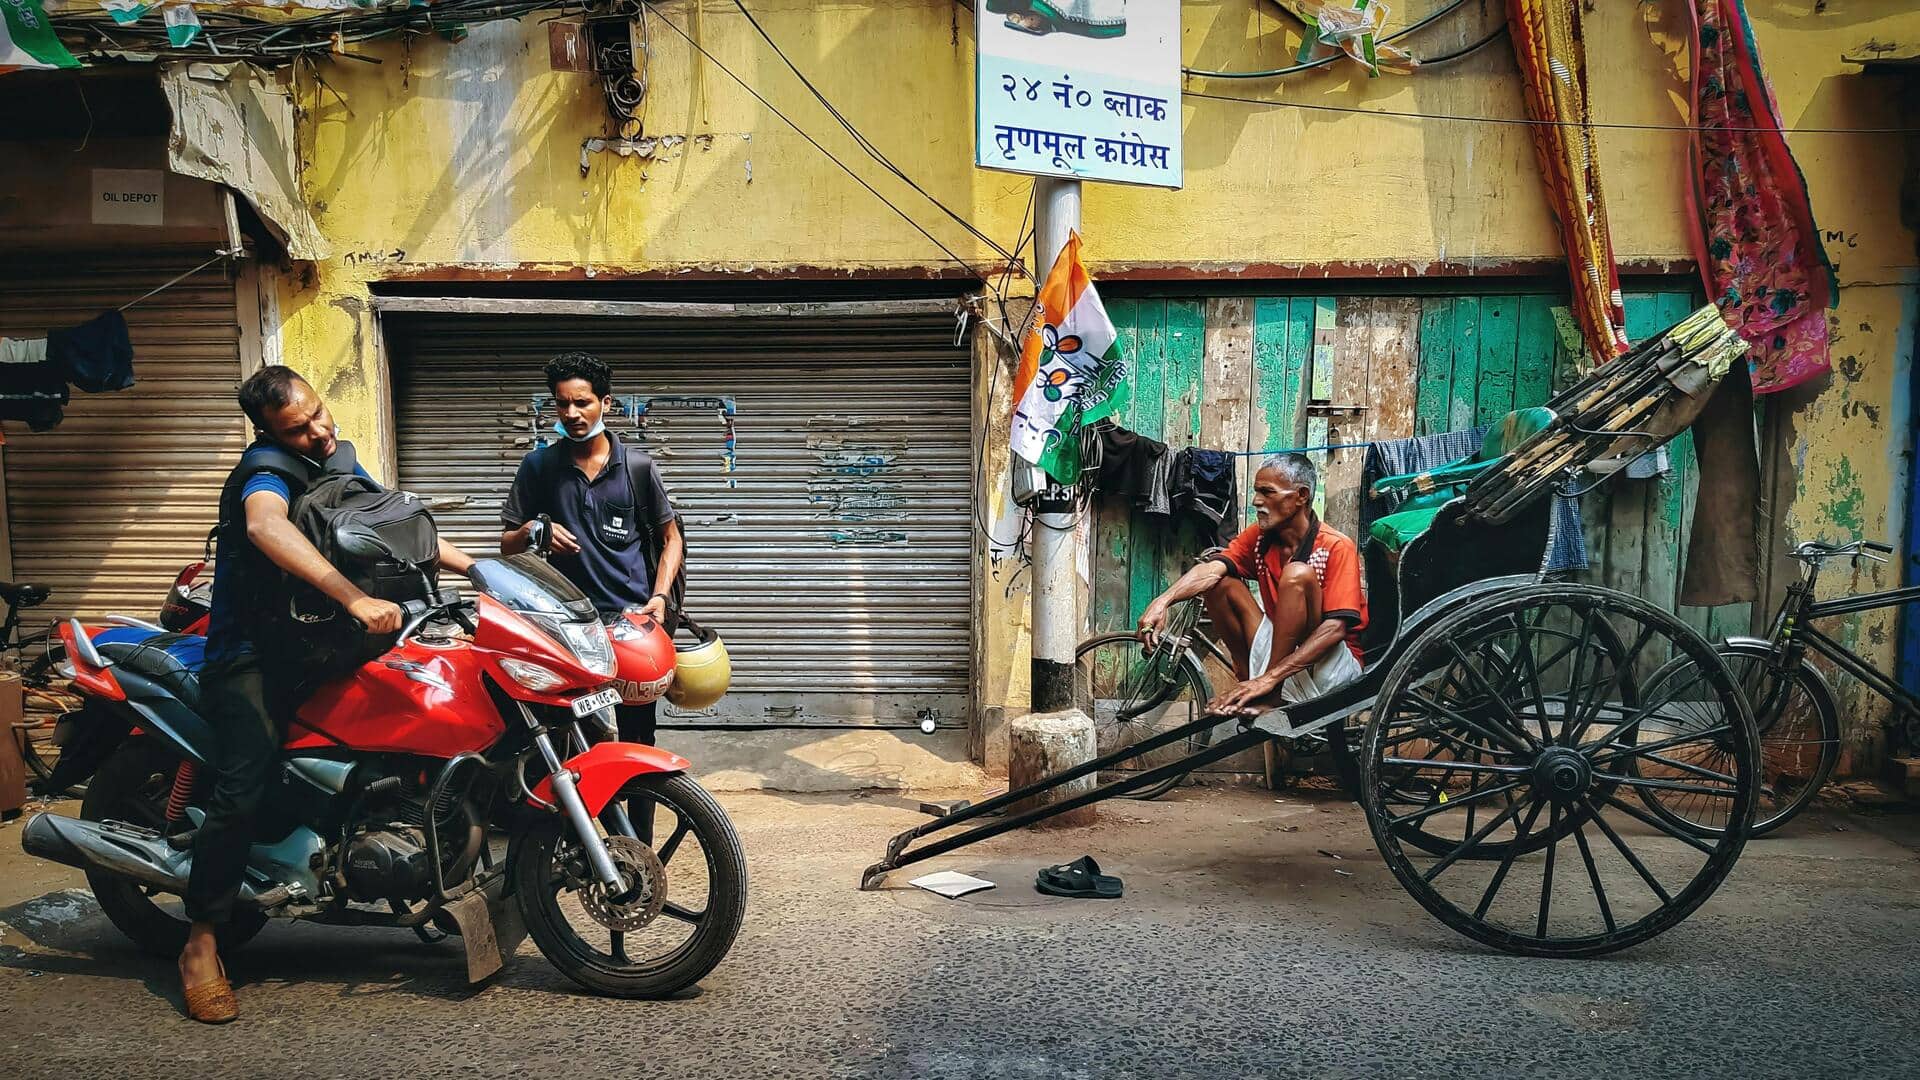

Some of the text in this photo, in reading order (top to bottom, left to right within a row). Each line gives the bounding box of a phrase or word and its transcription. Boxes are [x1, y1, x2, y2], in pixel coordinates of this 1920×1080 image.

[1002, 74, 1042, 101] २४
[1103, 89, 1168, 122] ब्लाक
[994, 124, 1171, 170] तृणमूल कांग्रेस
[102, 192, 159, 203] OIL DEPOT
